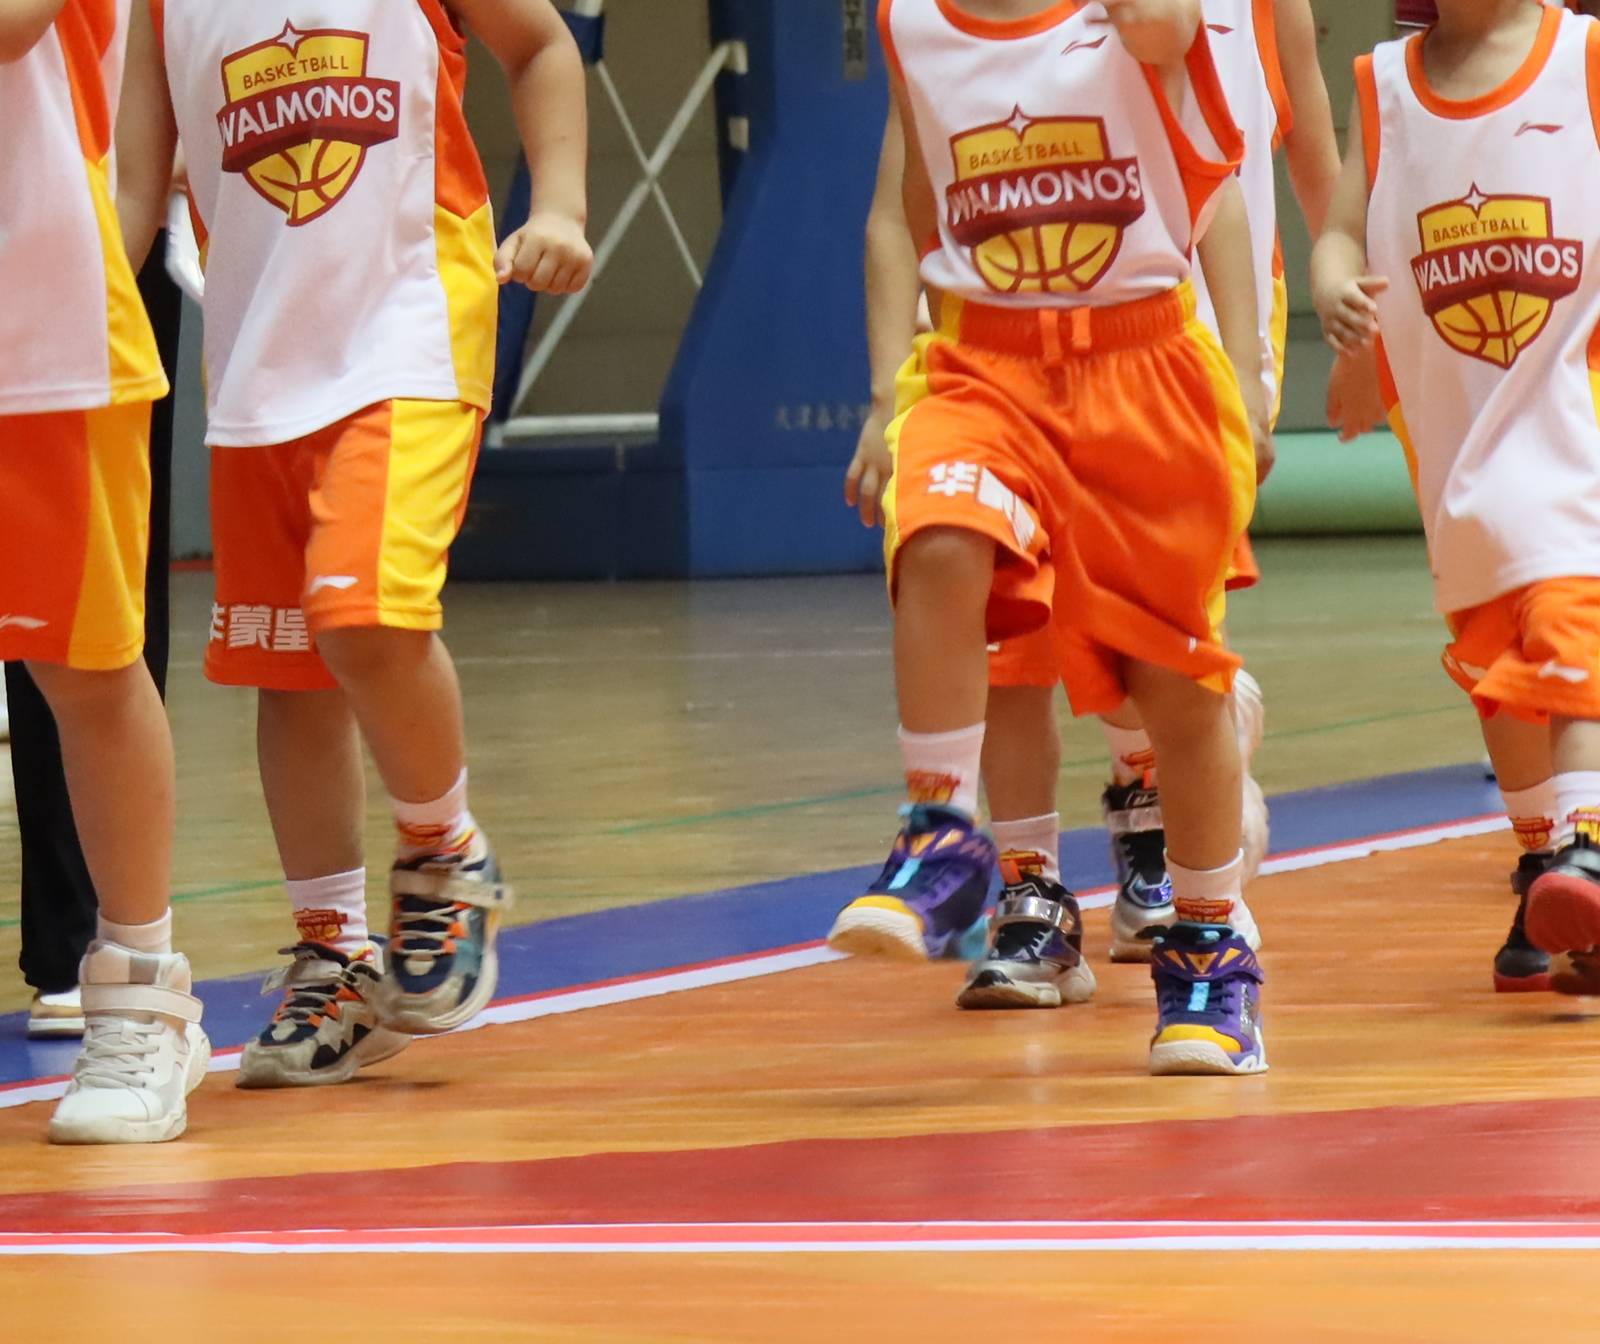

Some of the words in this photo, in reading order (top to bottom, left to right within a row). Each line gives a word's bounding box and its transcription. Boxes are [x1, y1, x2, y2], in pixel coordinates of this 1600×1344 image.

[242, 56, 350, 90] BASKETBALL
[969, 140, 1083, 170] BASKETBALL
[1432, 218, 1530, 244] BASKETBALL
[1414, 242, 1579, 293] WALMONOS
